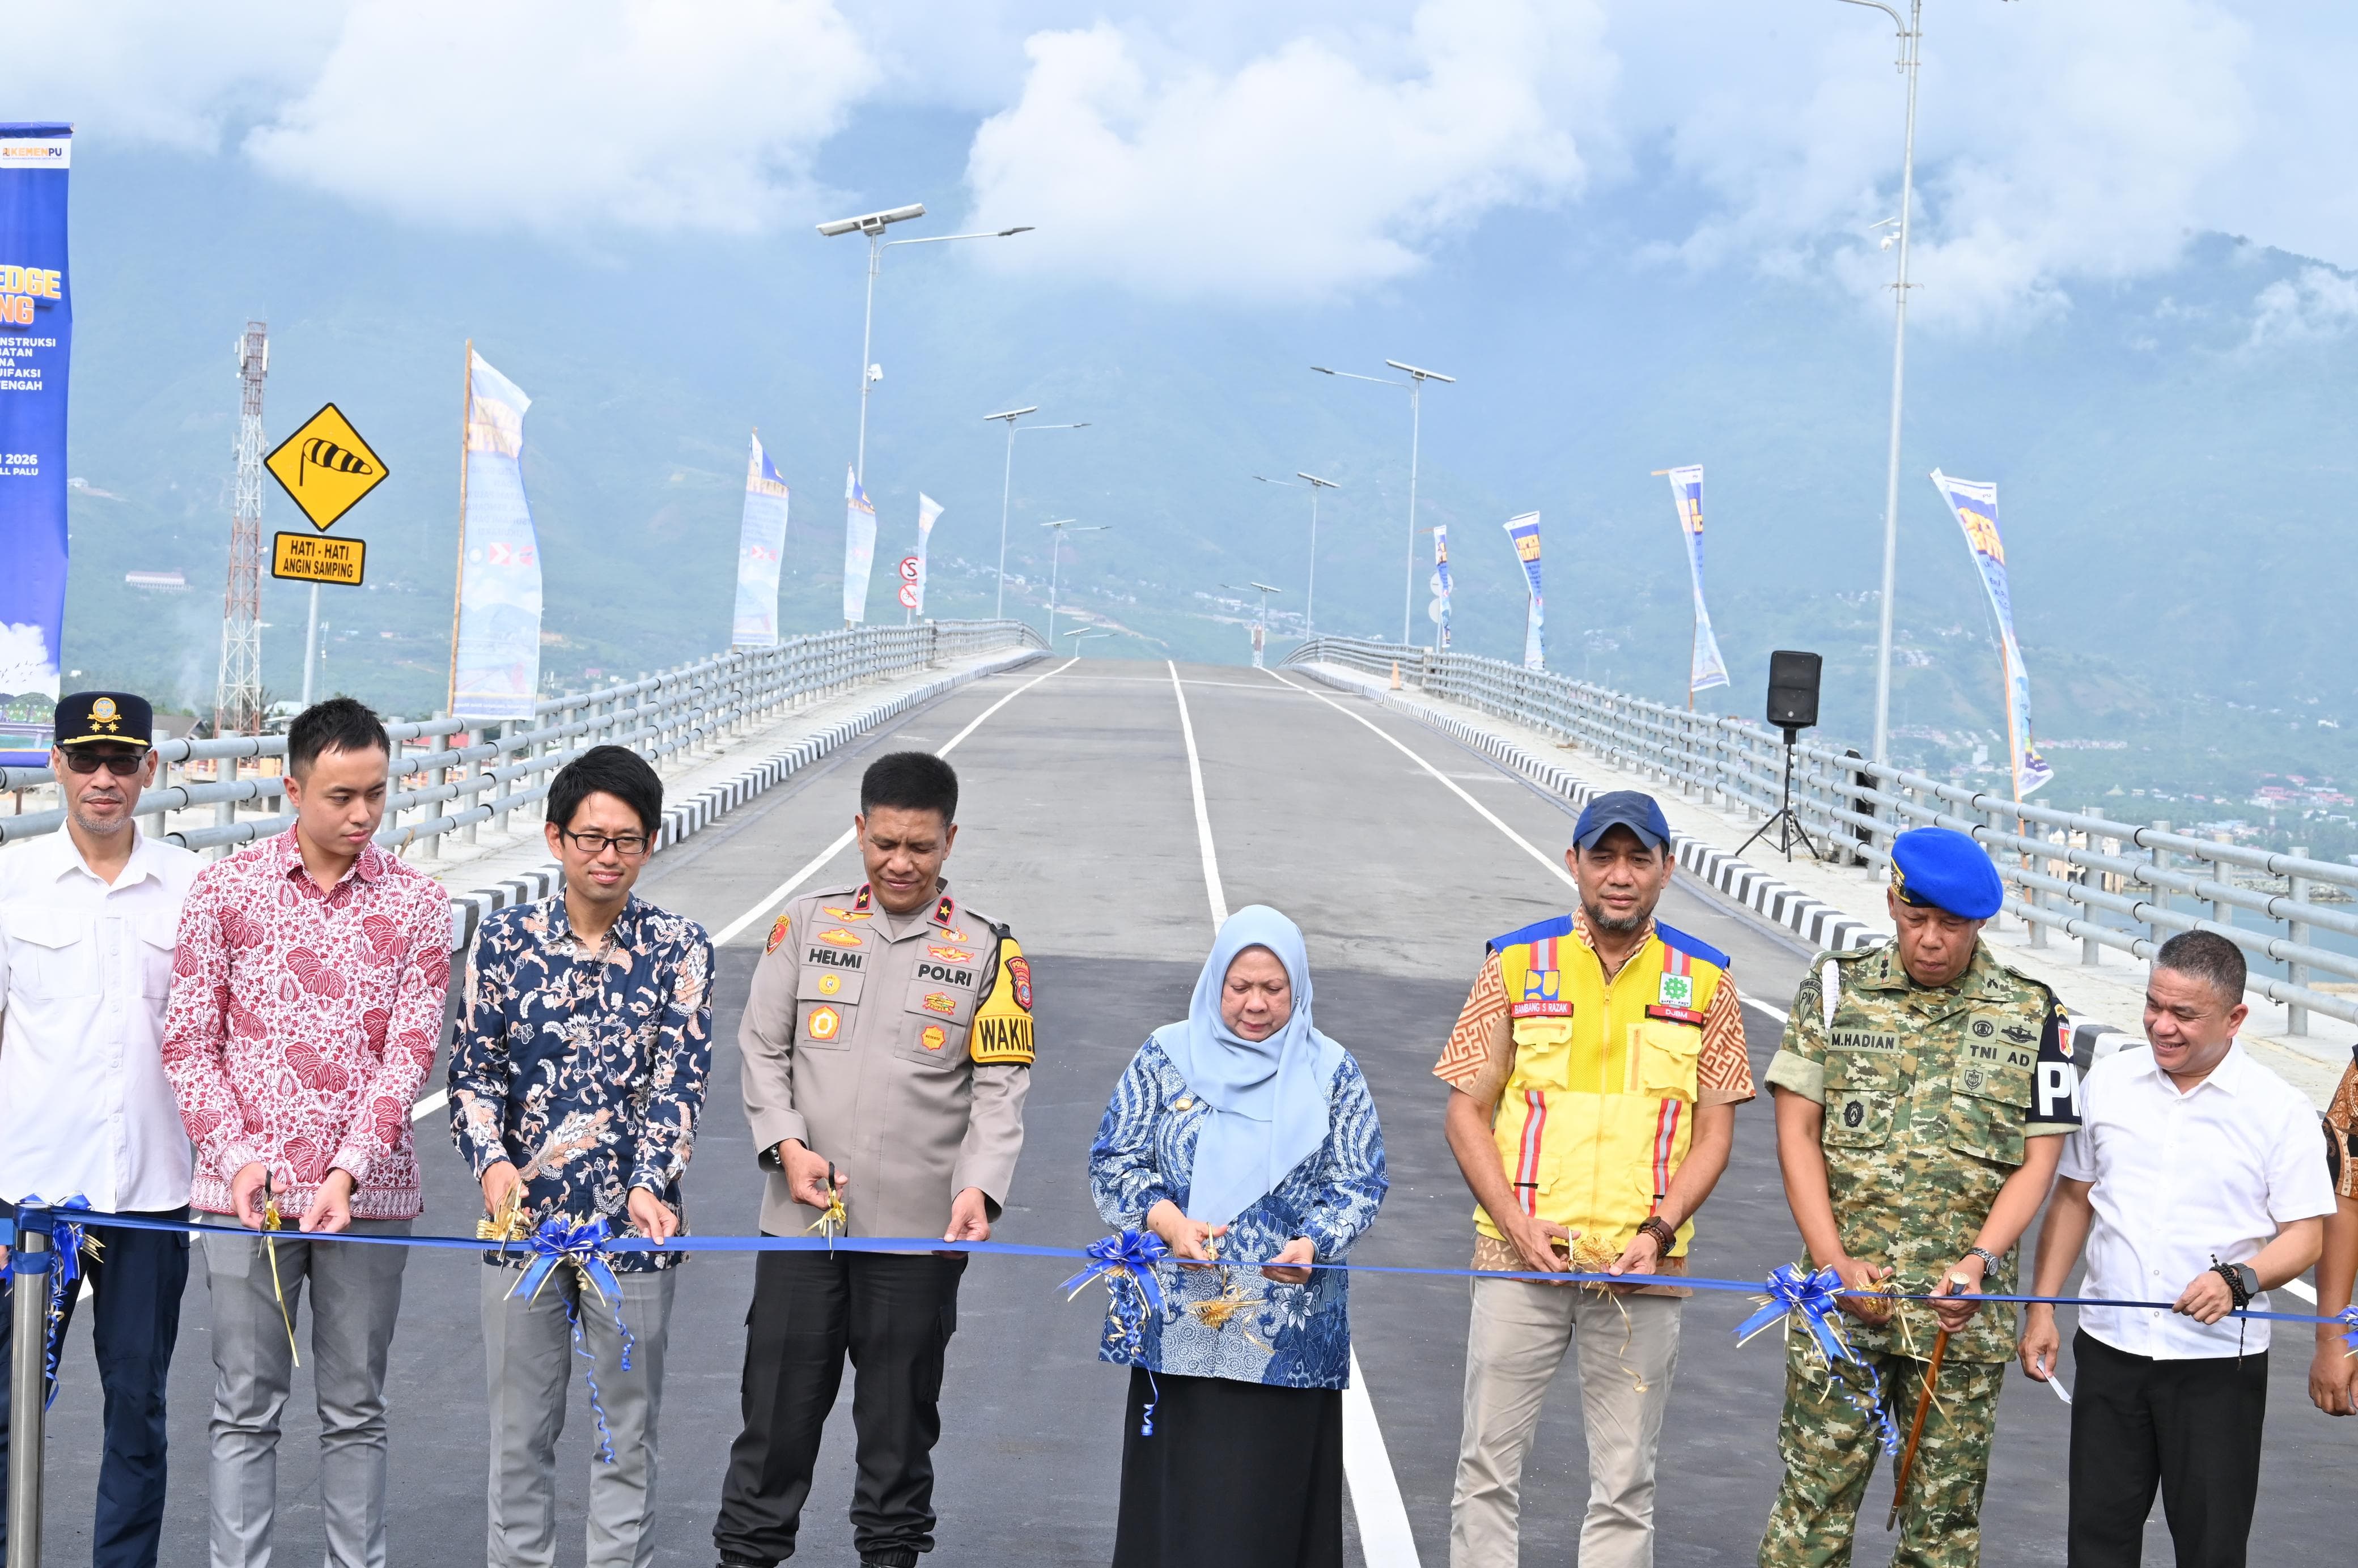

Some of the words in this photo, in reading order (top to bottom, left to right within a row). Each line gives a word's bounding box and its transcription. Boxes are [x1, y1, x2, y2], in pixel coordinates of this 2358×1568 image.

[0, 347, 33, 357] ATAN
[0, 380, 43, 390] ENGAH
[6, 453, 37, 465] 2026
[291, 539, 315, 557] HATI
[325, 543, 349, 561] HATI
[283, 558, 311, 574] ANGIN
[313, 560, 353, 578] SAMPING
[809, 948, 862, 968] HELMI
[918, 964, 972, 987] POLRI
[1514, 1002, 1540, 1014] BAMBANG
[1542, 1003, 1546, 1012] S
[1548, 1003, 1567, 1013] RAZAK
[1665, 1009, 1688, 1019] DJBM
[1831, 1033, 1895, 1049] M.HADIAN
[1970, 1044, 1997, 1060] TNI
[2007, 1051, 2030, 1067] AD
